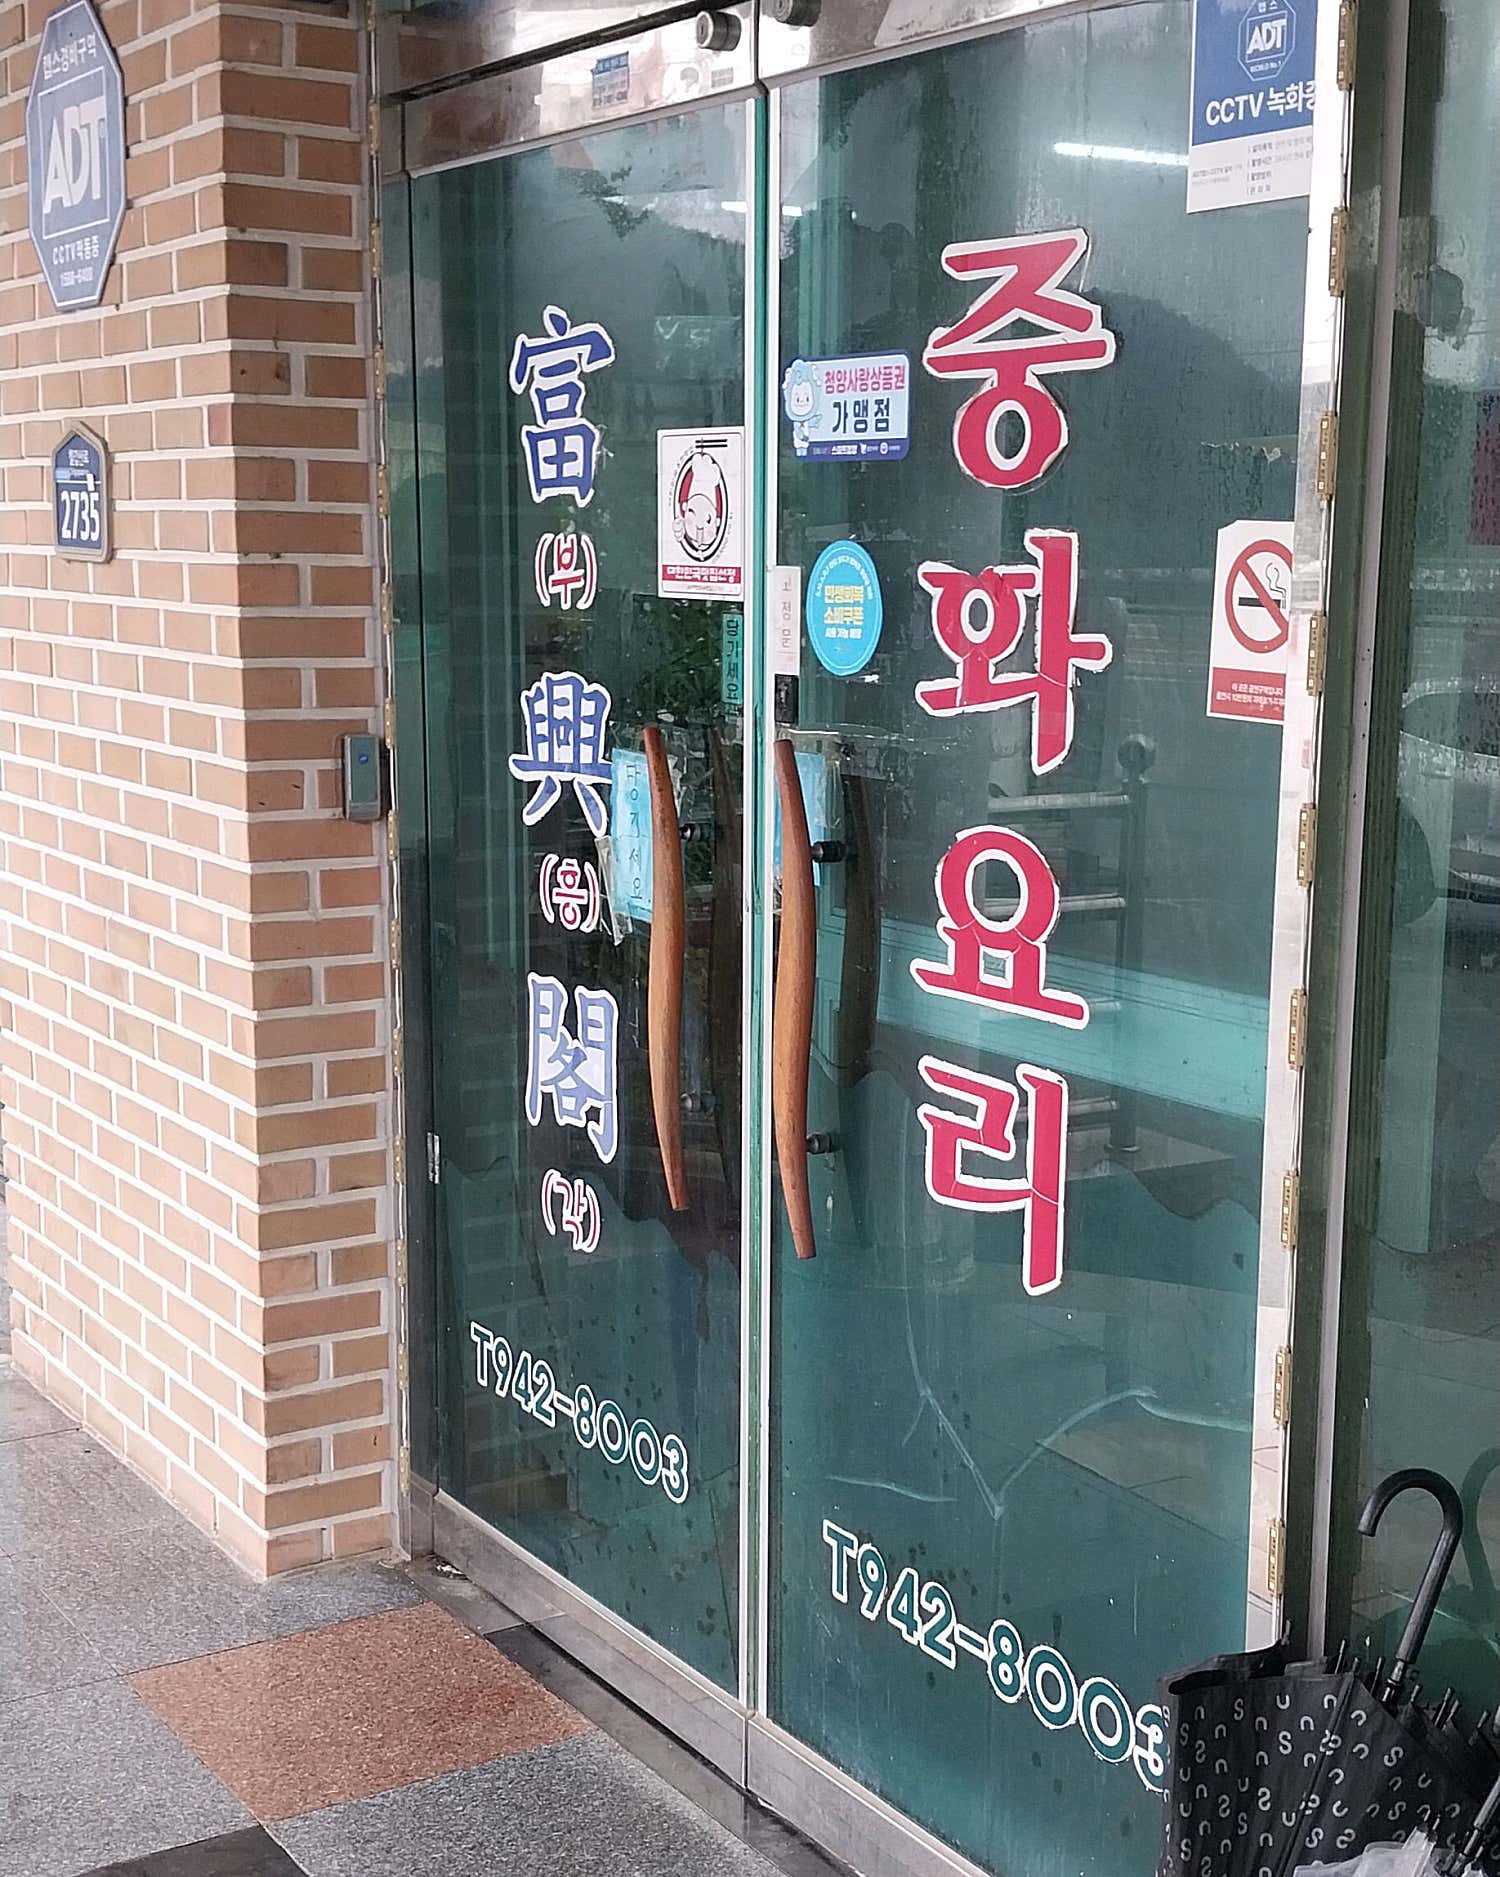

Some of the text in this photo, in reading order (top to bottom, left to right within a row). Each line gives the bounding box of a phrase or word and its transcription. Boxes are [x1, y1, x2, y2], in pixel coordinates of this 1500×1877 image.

[1247, 19, 1288, 55] ADT
[1206, 92, 1265, 127] CCTV
[43, 97, 106, 214] ADT
[824, 365, 906, 396] 청양사랑상품권
[831, 397, 891, 435] 가맹점
[61, 491, 100, 541] 2735
